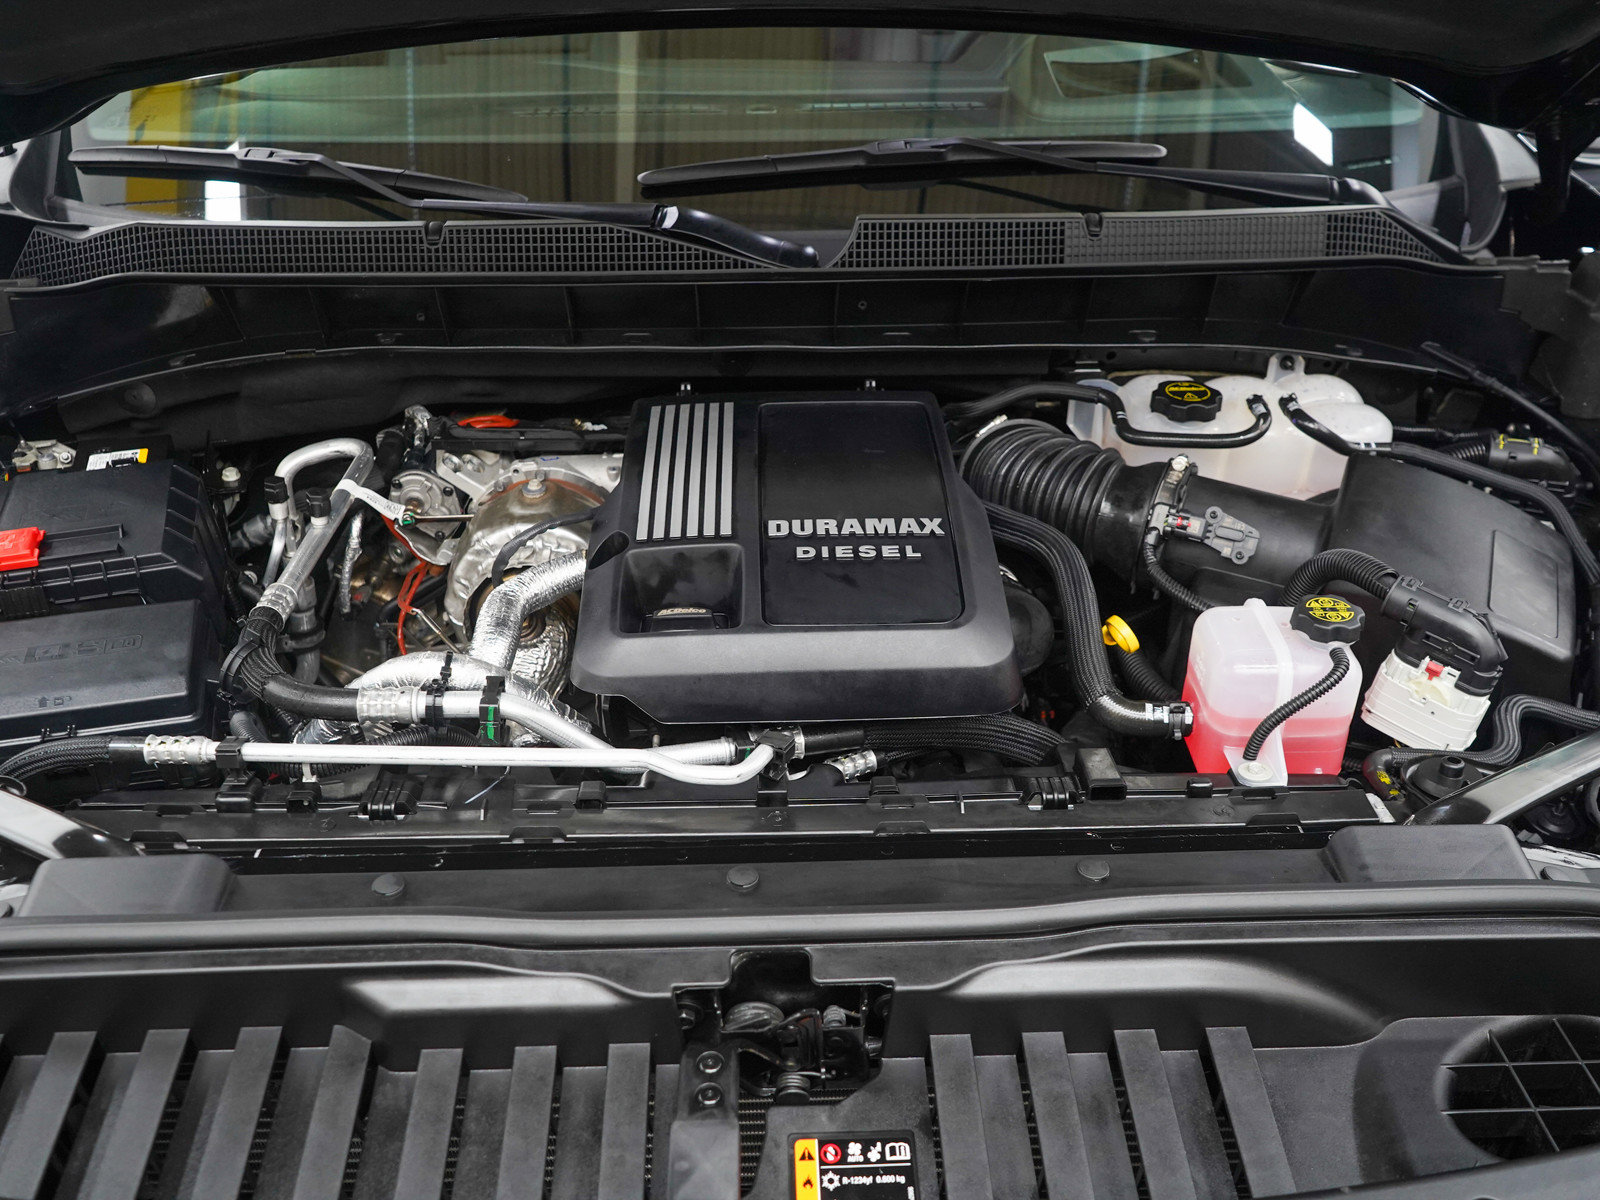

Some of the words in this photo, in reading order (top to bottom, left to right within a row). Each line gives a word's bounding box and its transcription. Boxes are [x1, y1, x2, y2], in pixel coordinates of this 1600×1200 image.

[768, 517, 945, 537] DURAMAX
[796, 545, 922, 560] DIESEL
[657, 607, 707, 616] ACDelco
[847, 1154, 864, 1163] AUTO
[896, 1174, 906, 1184] kg
